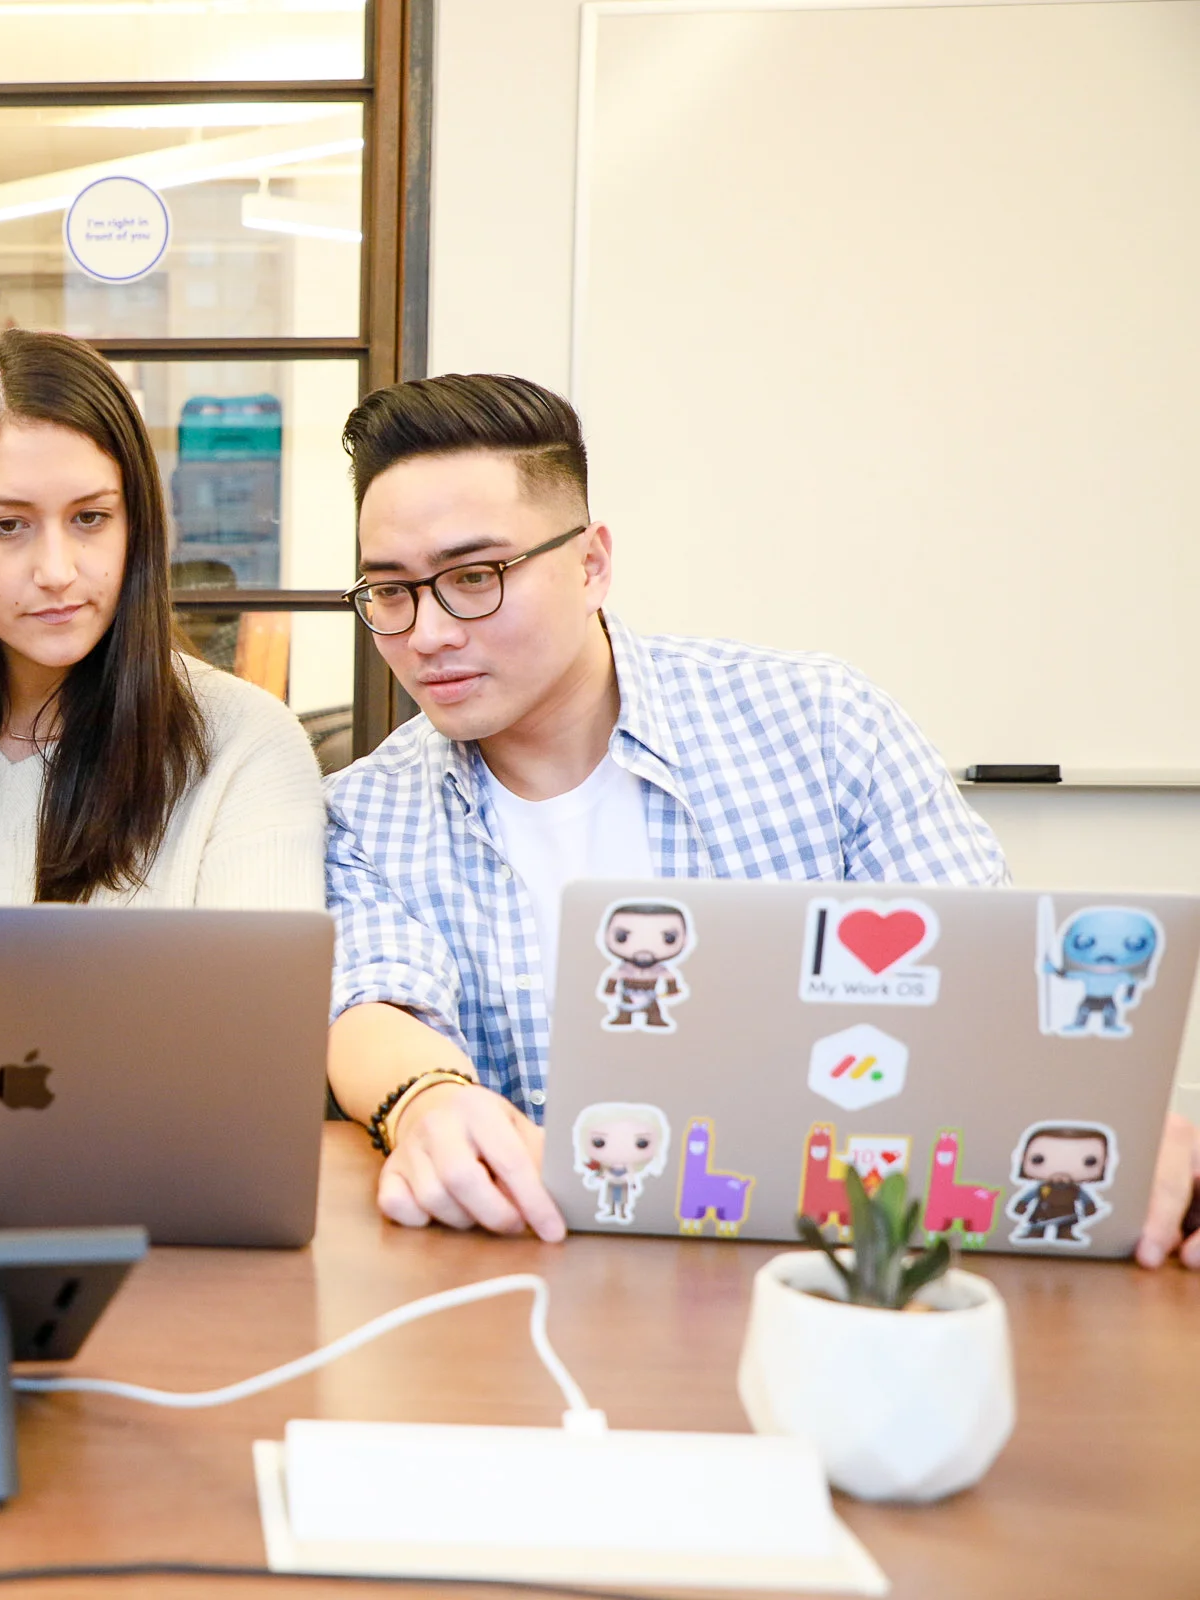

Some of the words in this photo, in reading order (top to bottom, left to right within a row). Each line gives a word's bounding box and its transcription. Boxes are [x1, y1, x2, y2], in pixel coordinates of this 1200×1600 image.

[87, 218, 104, 227] I'm
[108, 218, 135, 229] right
[138, 218, 149, 226] in
[85, 232, 113, 241] front
[116, 230, 128, 240] of
[131, 232, 150, 243] you
[812, 908, 827, 976] I
[809, 982, 836, 996] My
[843, 982, 889, 995] Work
[896, 982, 925, 997] OS
